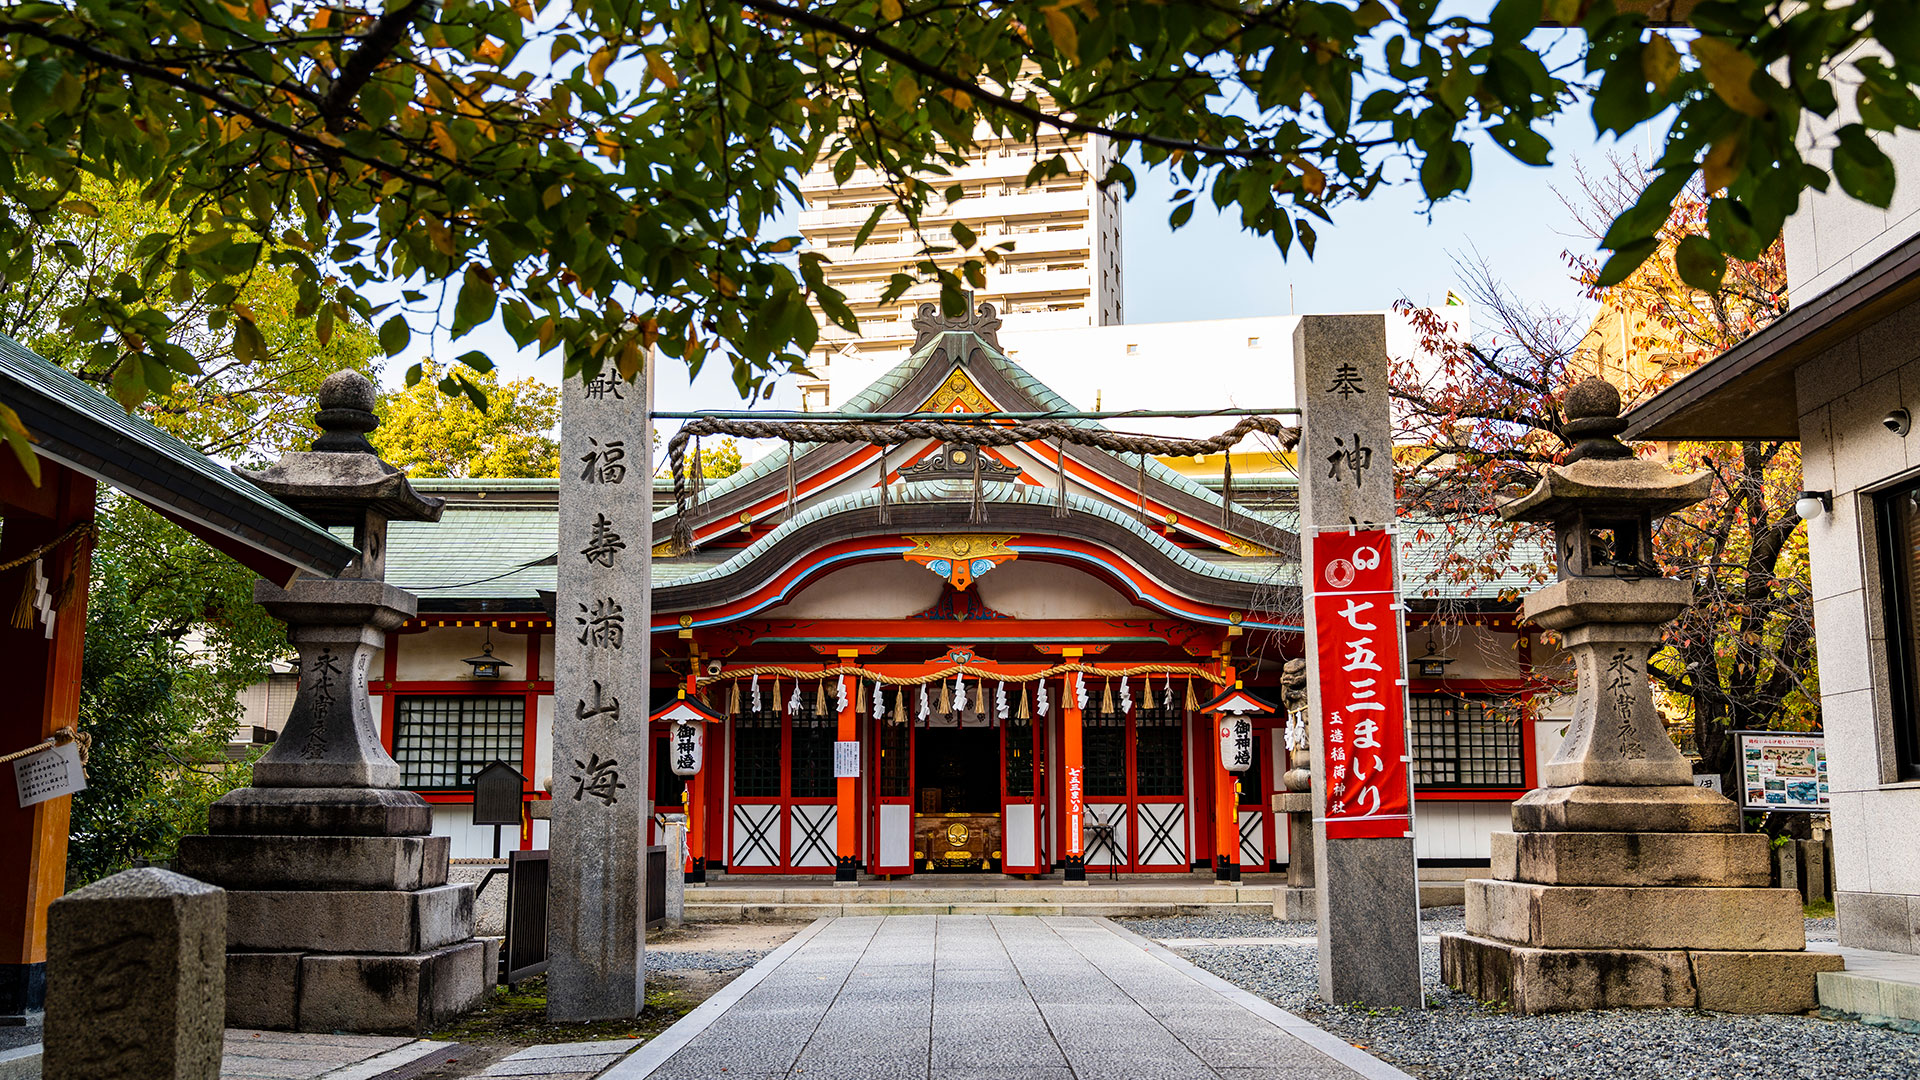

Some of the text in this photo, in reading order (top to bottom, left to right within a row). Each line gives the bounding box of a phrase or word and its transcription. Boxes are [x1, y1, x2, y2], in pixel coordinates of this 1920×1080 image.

[1326, 362, 1374, 532] 奉神
[1233, 719, 1250, 765] 御神燈
[1337, 598, 1385, 817] 七五三まいり
[676, 723, 696, 770] 御神燈
[1329, 710, 1346, 814] 玉造稲荷神社
[1068, 767, 1081, 812] 七五三まいり
